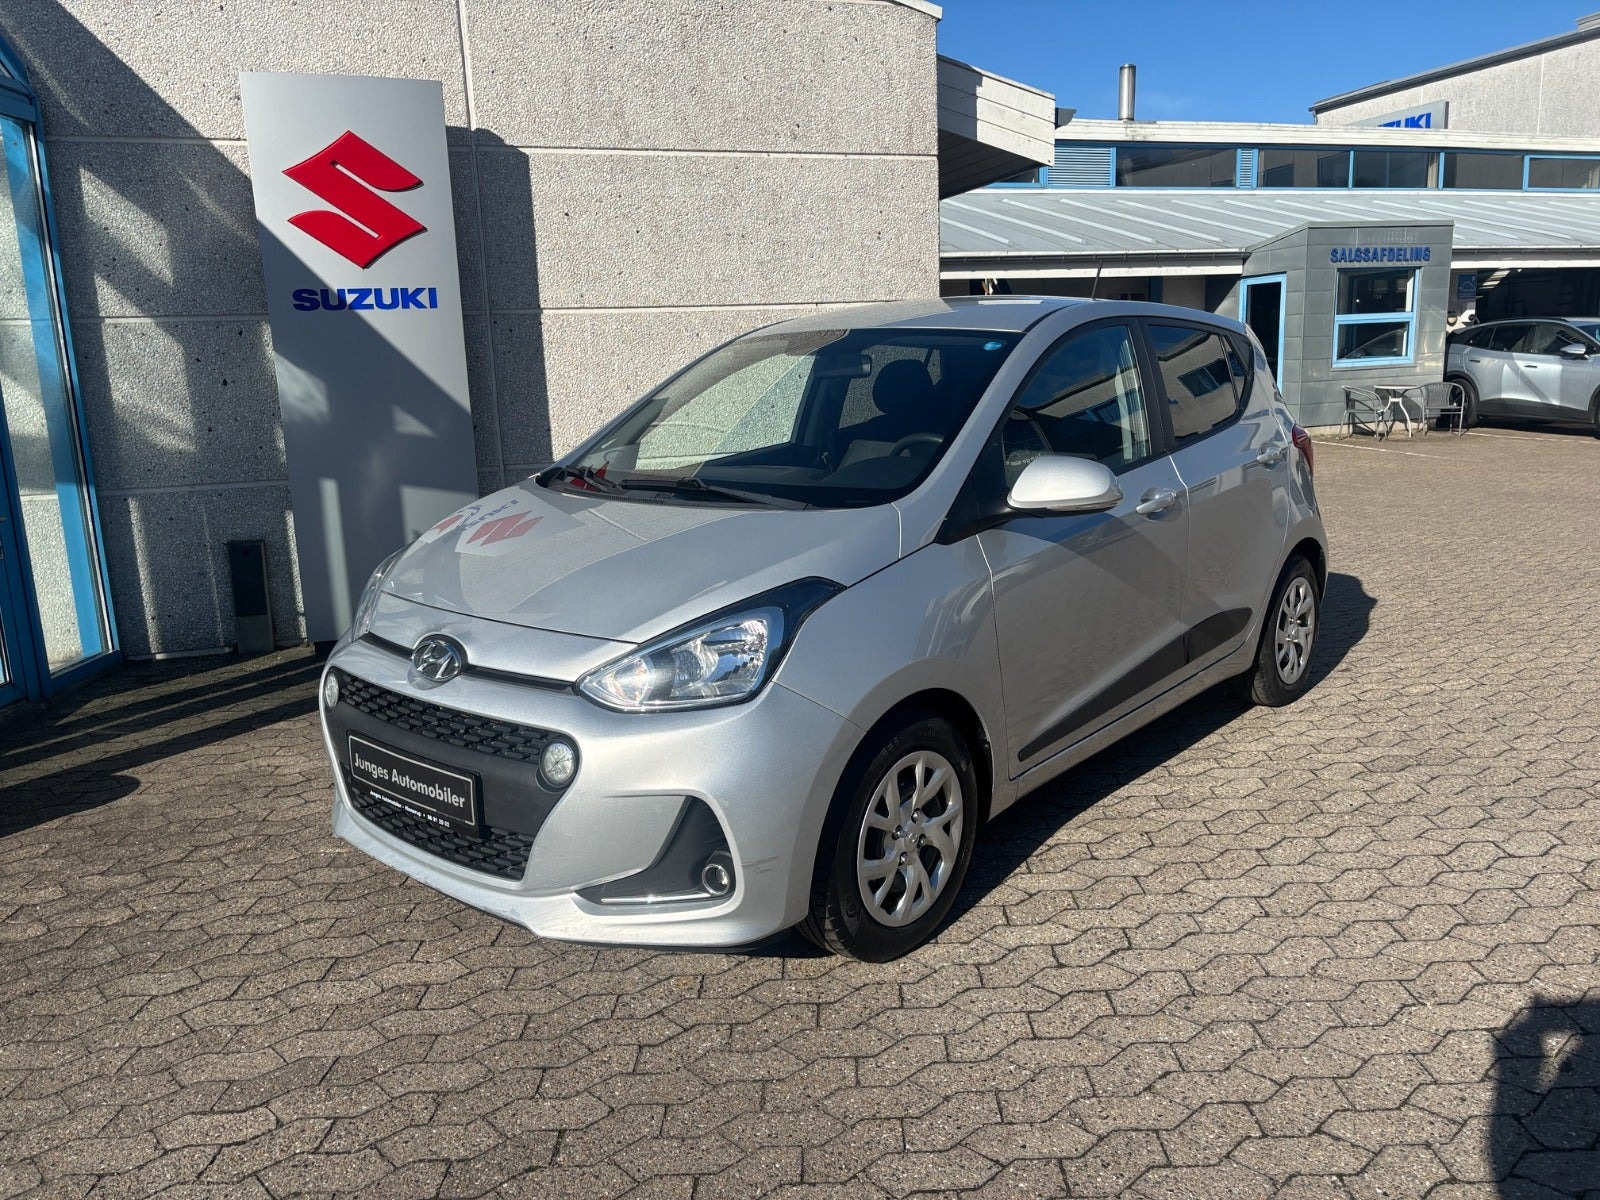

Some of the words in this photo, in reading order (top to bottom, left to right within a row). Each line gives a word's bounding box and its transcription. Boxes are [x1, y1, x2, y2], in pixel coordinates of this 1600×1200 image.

[1330, 247, 1431, 263] SALGSAFDELING
[292, 287, 438, 311] SUZUKI
[355, 752, 389, 780] Junges
[391, 768, 465, 808] Automobiler
